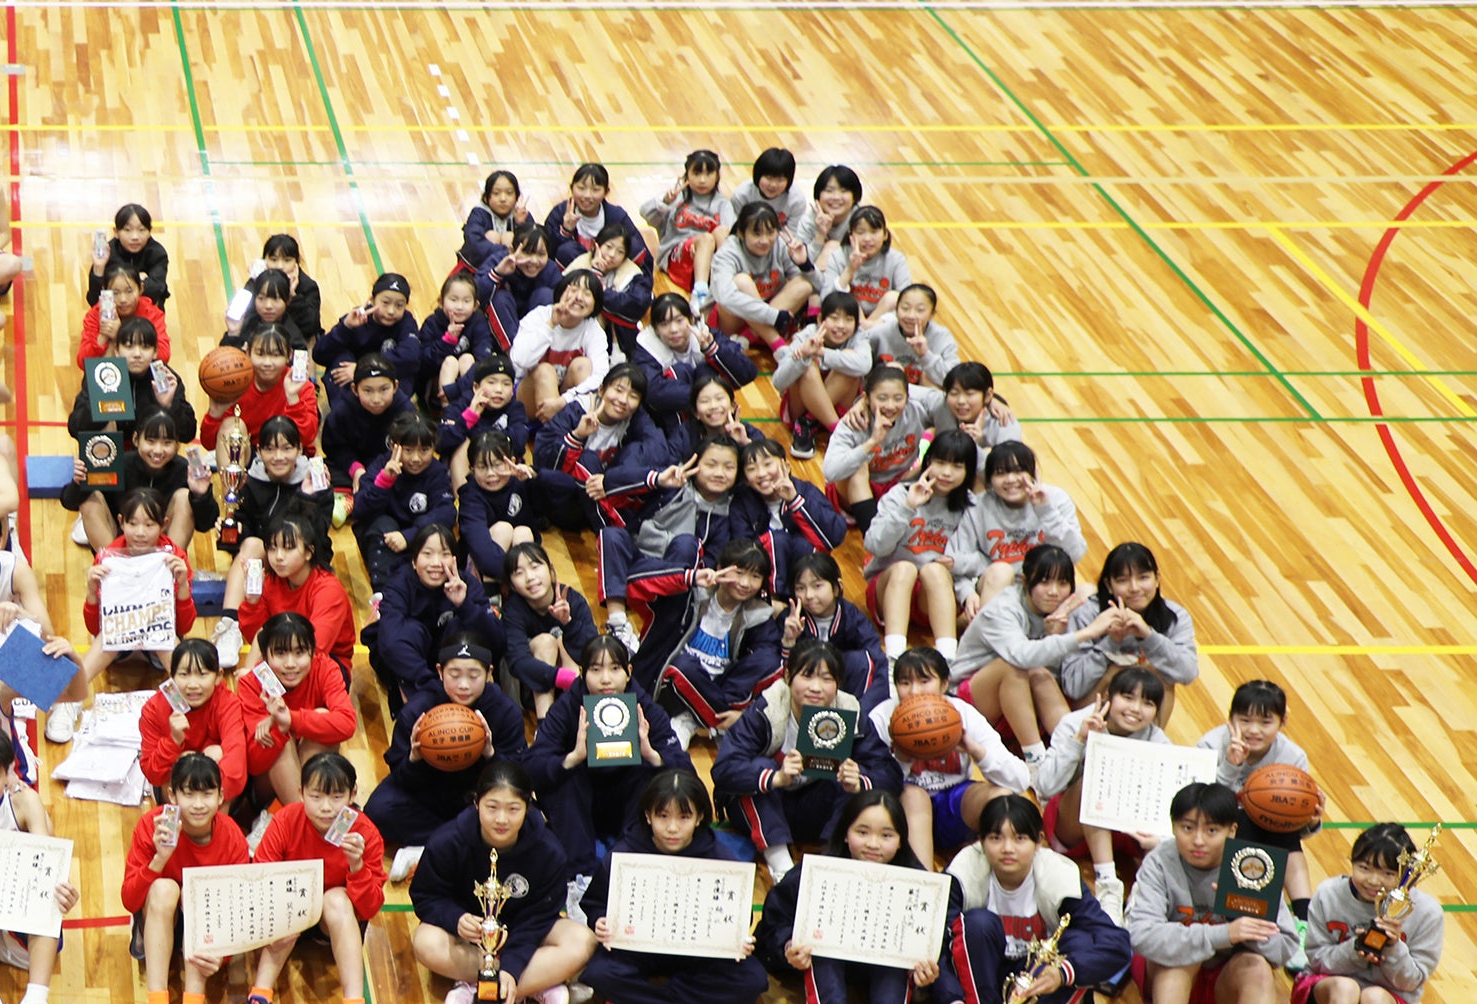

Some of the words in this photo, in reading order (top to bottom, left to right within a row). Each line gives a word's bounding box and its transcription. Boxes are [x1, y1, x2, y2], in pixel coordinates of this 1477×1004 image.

[902, 709, 931, 722] ALINCO
[428, 728, 456, 738] ALINCO
[459, 726, 474, 734] CUP
